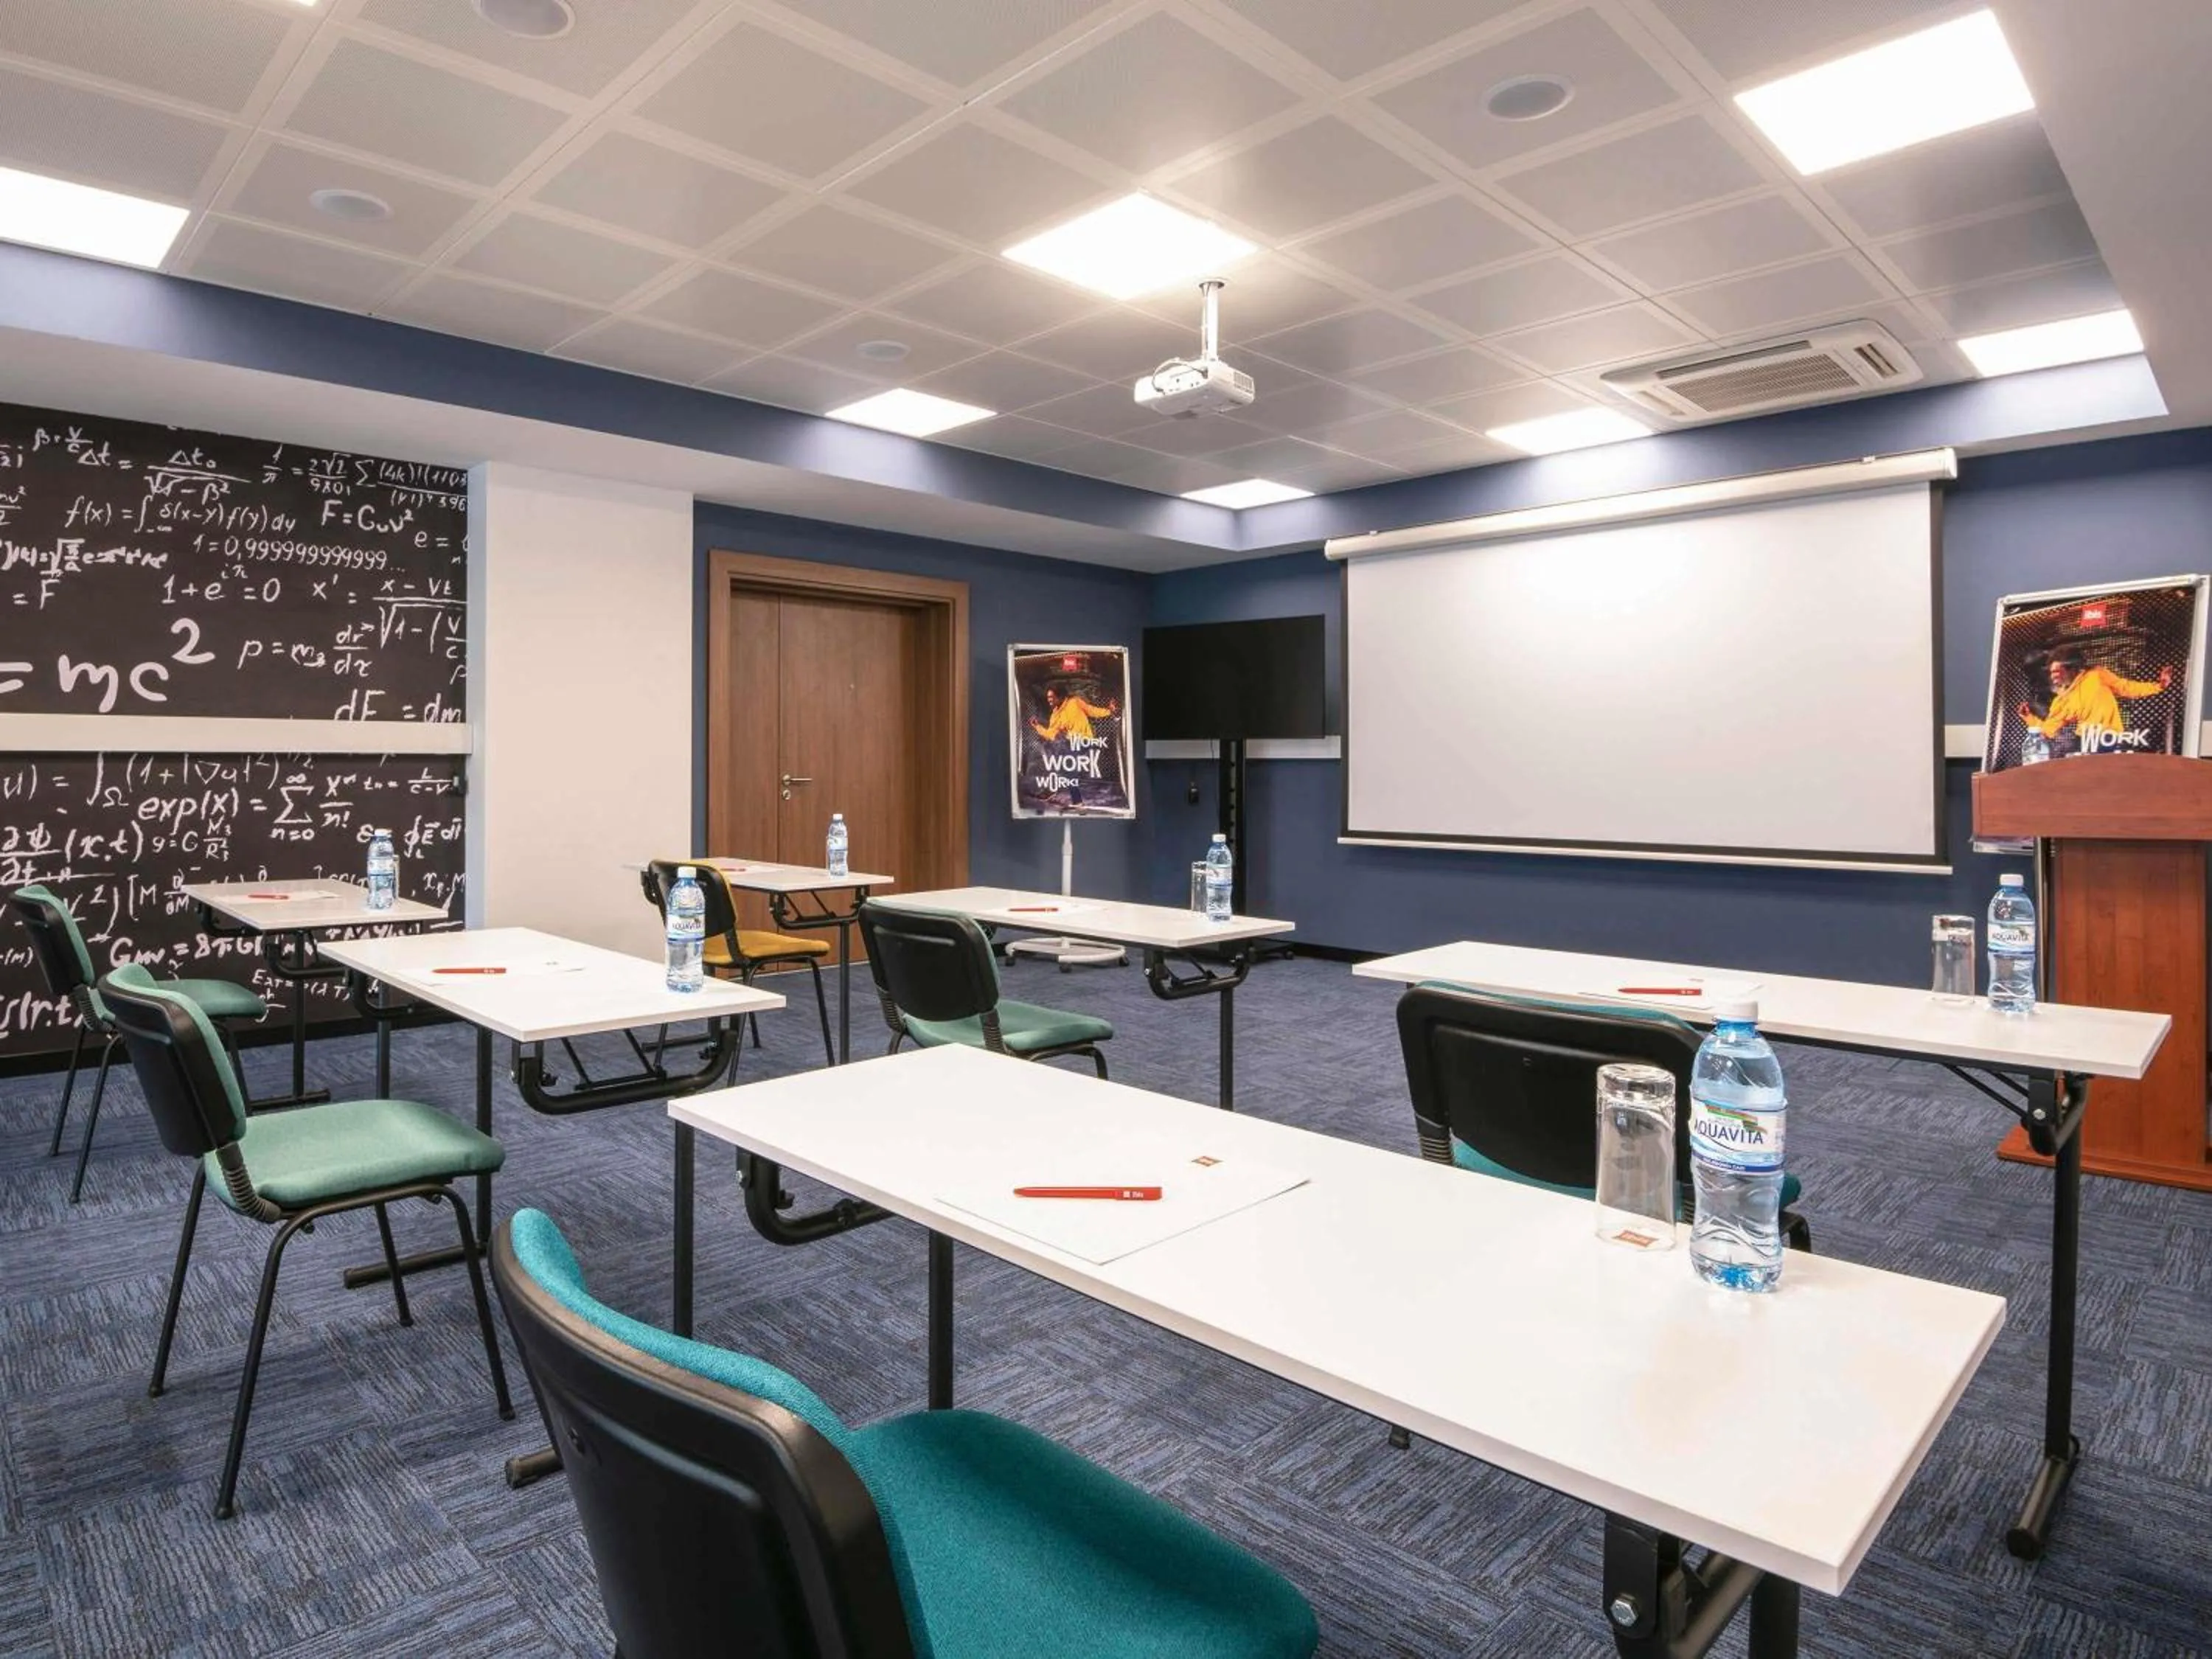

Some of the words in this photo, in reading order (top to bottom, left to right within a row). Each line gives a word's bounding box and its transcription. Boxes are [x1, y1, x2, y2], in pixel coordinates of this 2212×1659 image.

[1069, 734, 1107, 752] WORK
[2079, 723, 2150, 753] WORK
[1042, 749, 1102, 779] WORK
